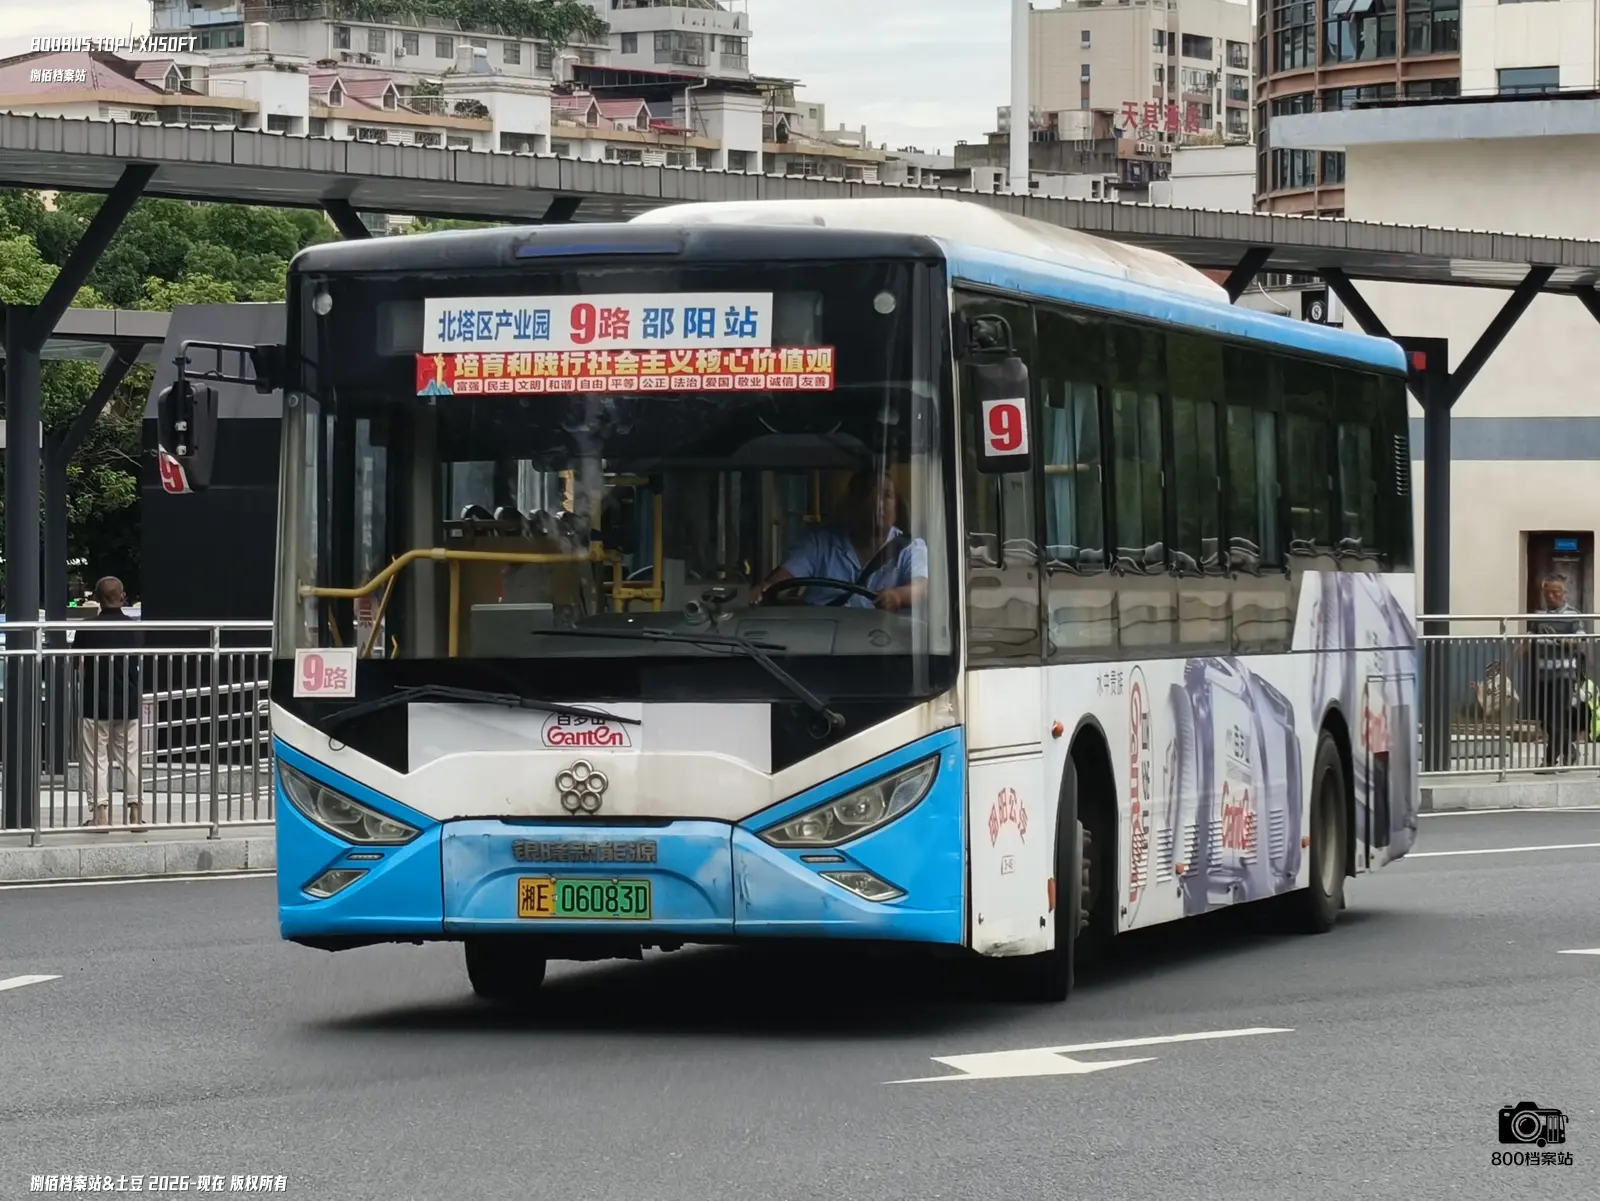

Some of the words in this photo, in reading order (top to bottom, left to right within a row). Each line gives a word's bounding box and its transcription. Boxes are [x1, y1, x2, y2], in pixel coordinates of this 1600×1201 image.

[438, 309, 550, 342] 北塔区产业园
[570, 303, 630, 344] 9路
[642, 305, 758, 340] 邵阳站
[454, 348, 832, 378] 培育和践行社会主义核心价值观
[457, 381, 479, 391] 富强
[487, 381, 510, 391] 民主
[518, 380, 541, 391] 文明
[549, 379, 571, 390] 和谐
[580, 379, 602, 389] 自由
[611, 378, 634, 389] 平等
[642, 378, 666, 388] 公正
[674, 377, 698, 388] 法治
[705, 377, 730, 388] 爱国
[738, 377, 762, 387] 敬业
[770, 377, 793, 387] 诚信
[801, 376, 826, 387] 友善
[988, 404, 1023, 451] 9
[161, 451, 186, 493] 9
[303, 654, 348, 691] 9路
[512, 839, 658, 863] 银隆新能源
